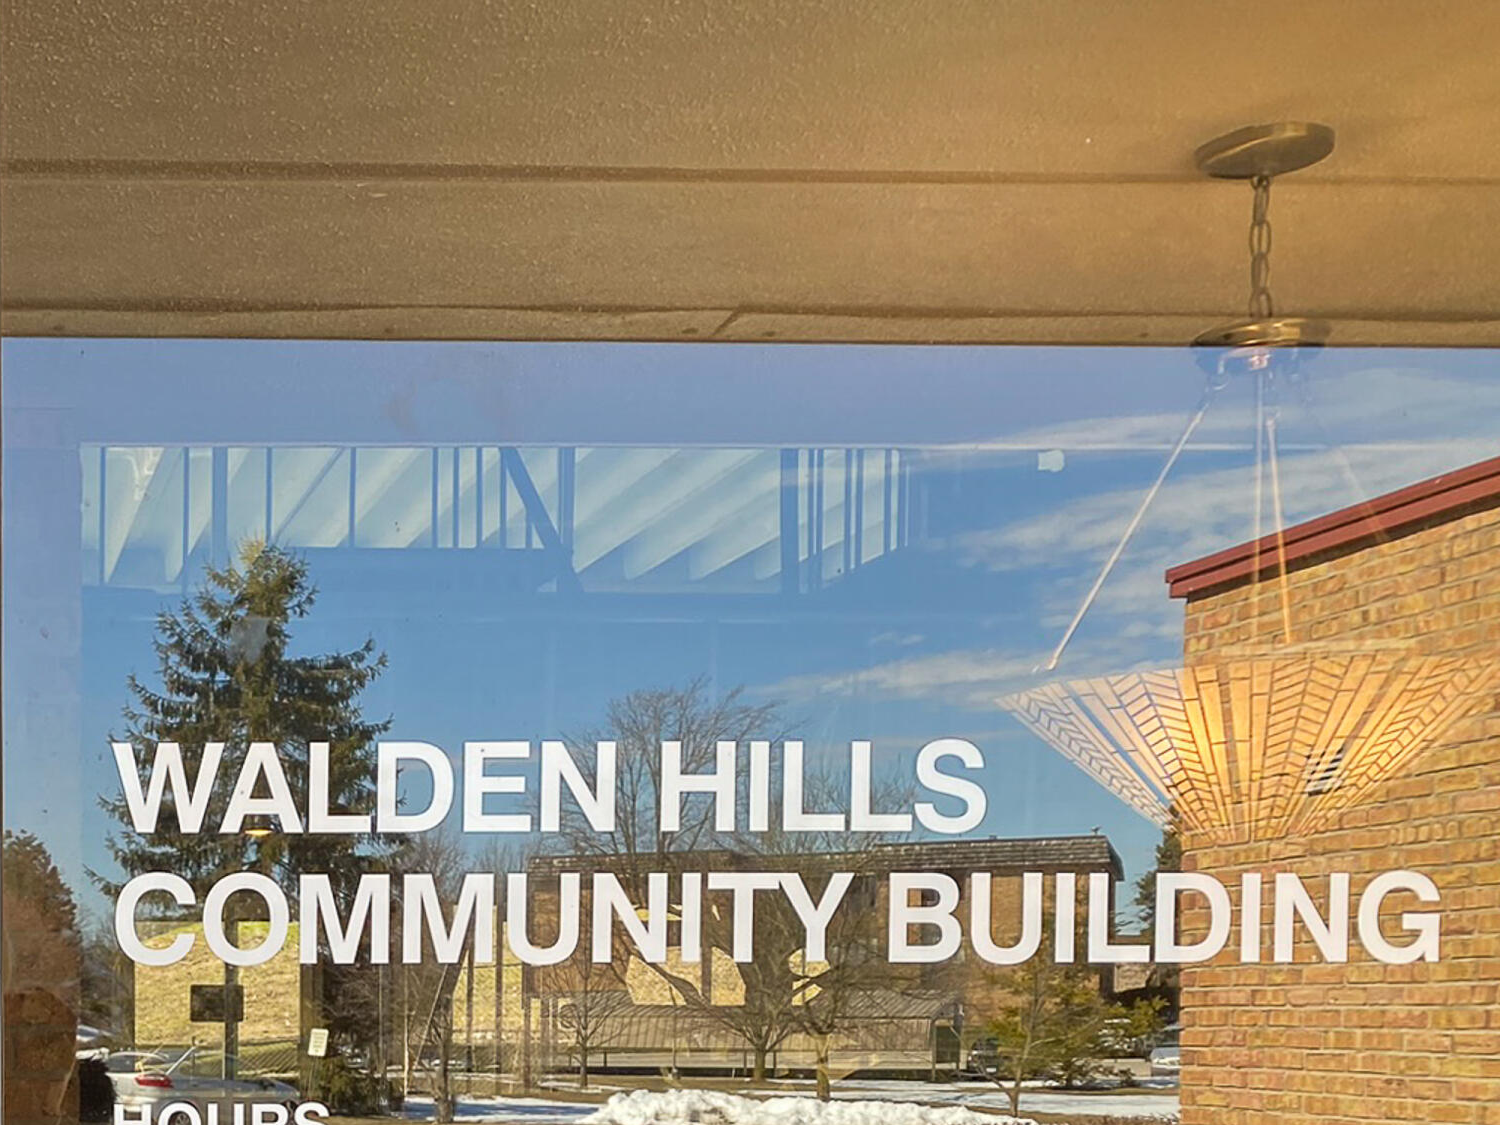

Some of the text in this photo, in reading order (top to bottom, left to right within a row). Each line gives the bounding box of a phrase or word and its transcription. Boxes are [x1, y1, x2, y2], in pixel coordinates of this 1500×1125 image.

[111, 738, 987, 835] WALDEN HILLS
[114, 870, 1441, 967] COMMUNITY BUILDING
